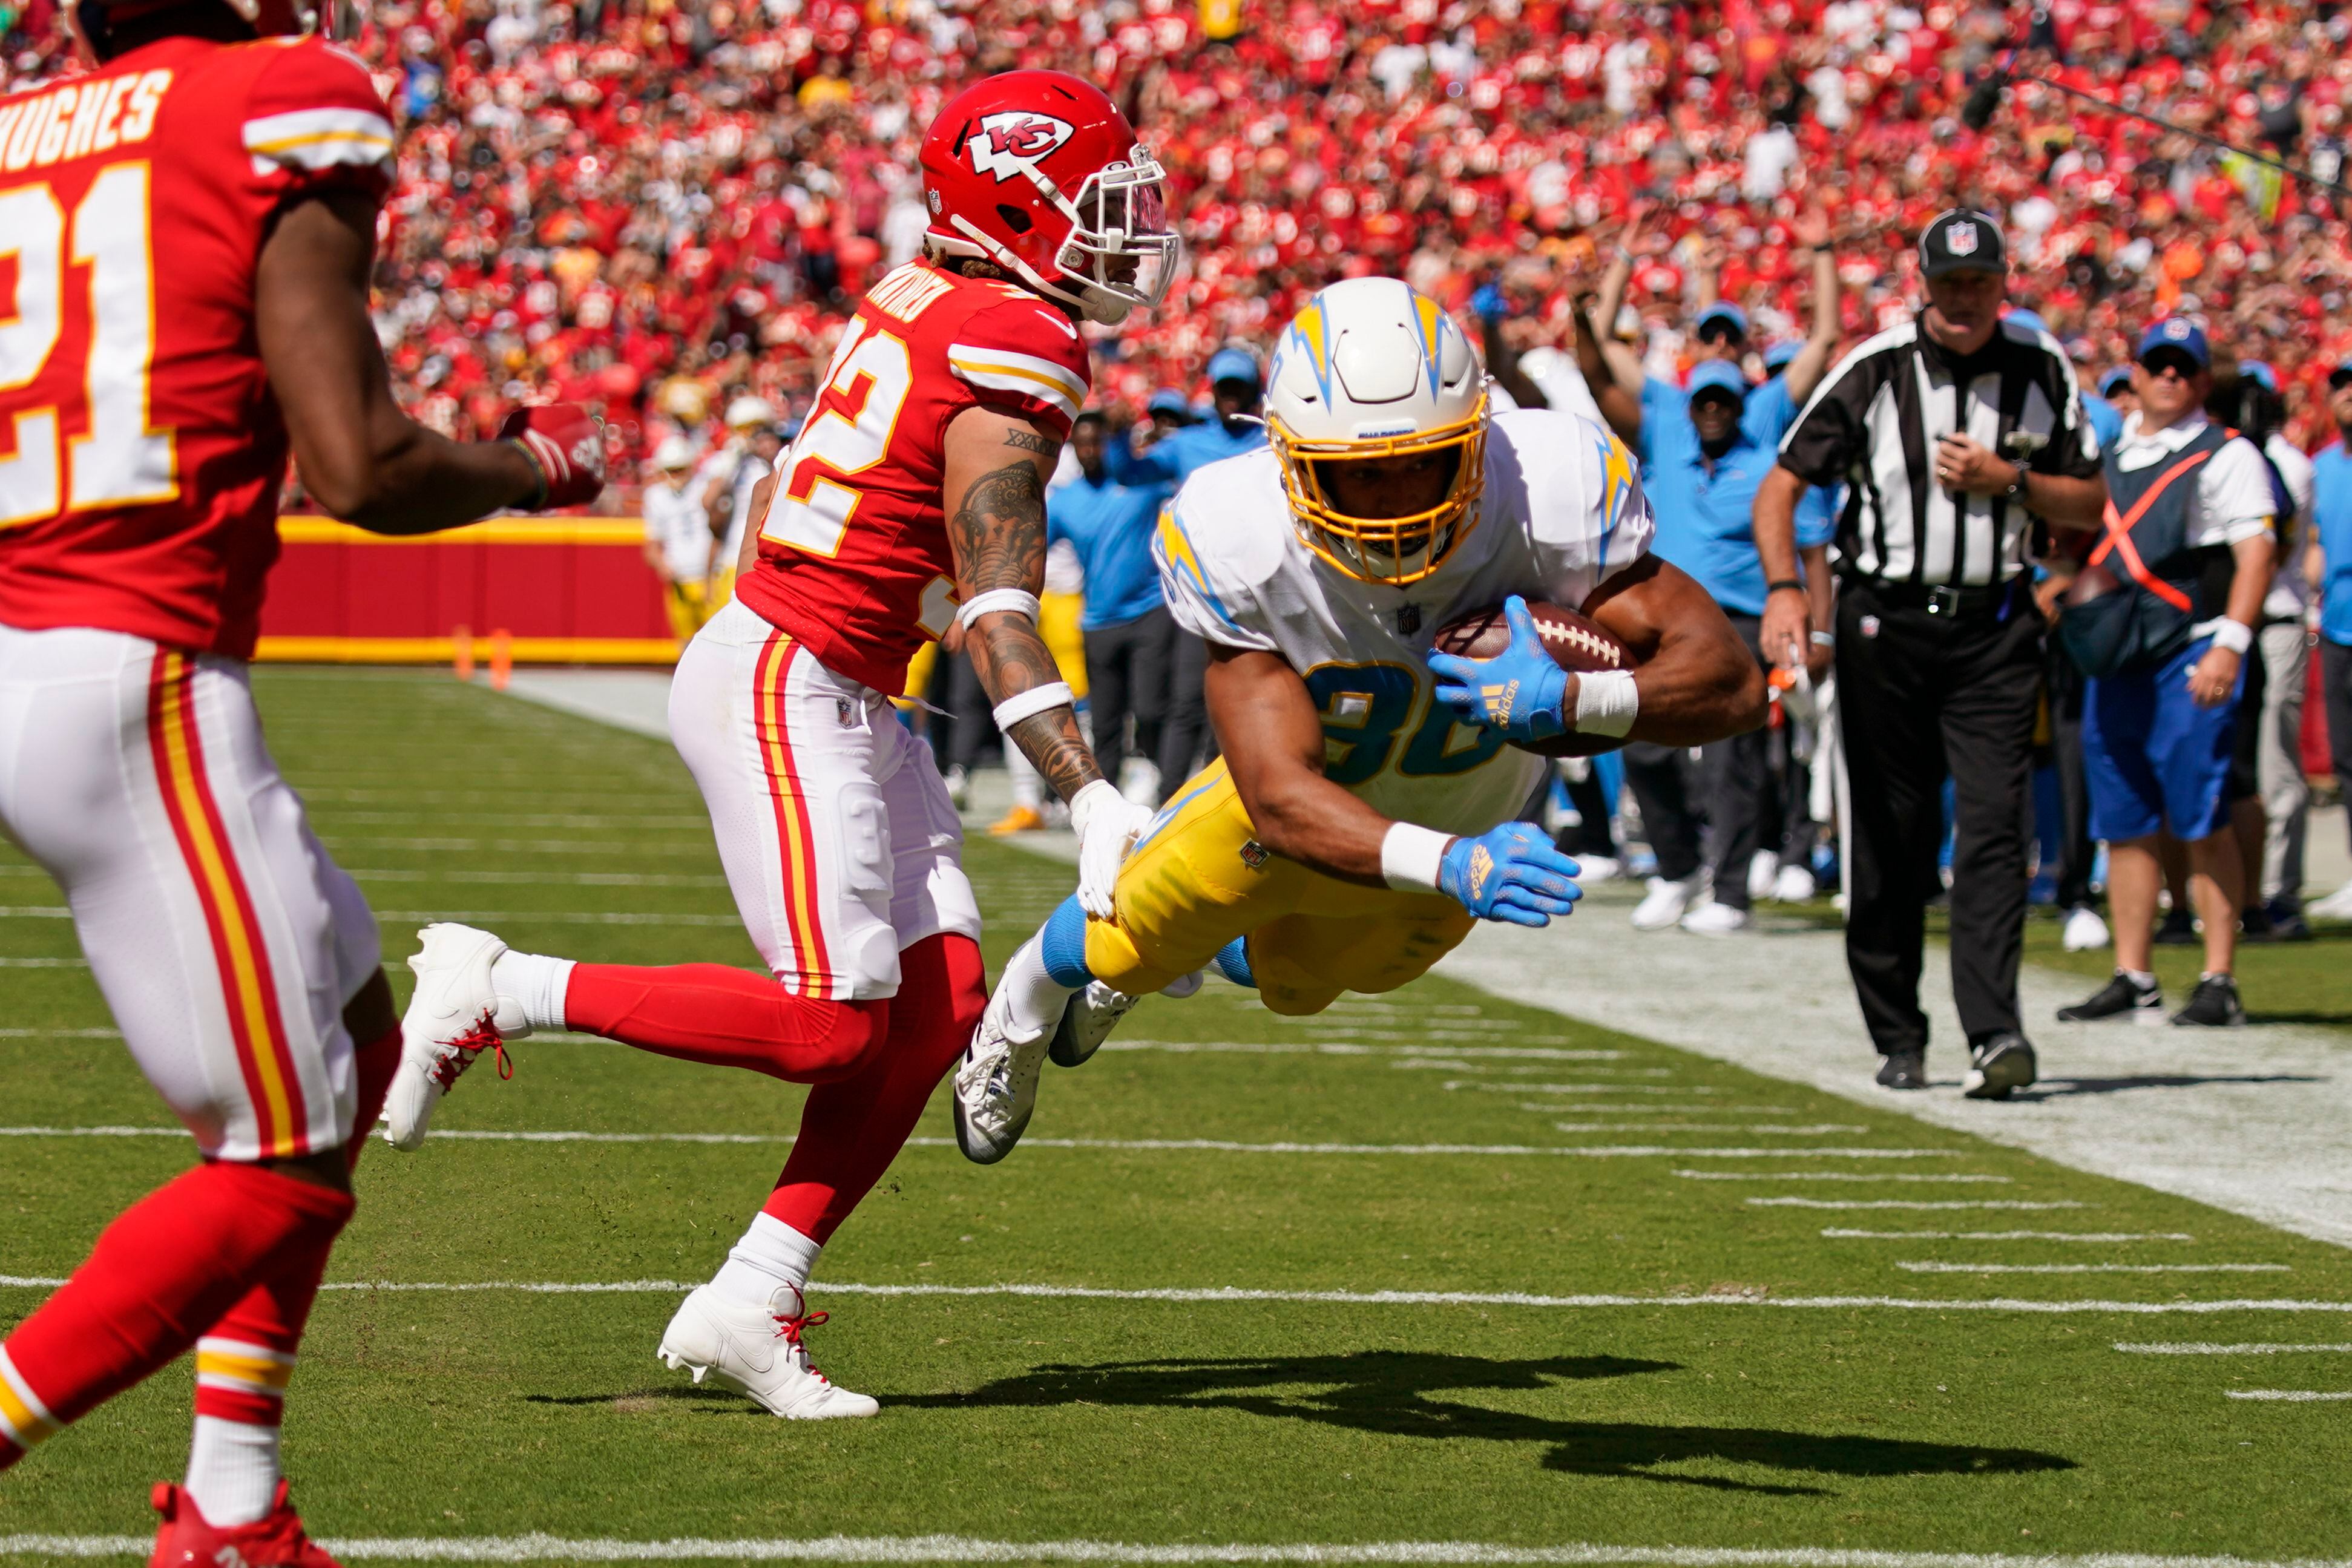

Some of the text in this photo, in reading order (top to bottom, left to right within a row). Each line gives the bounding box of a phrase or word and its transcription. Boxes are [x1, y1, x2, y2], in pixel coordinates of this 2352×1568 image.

[987, 117, 1058, 157] KC
[760, 312, 914, 559] 2
[1497, 678, 1520, 730] adidas
[1470, 844, 1483, 901] adidas
